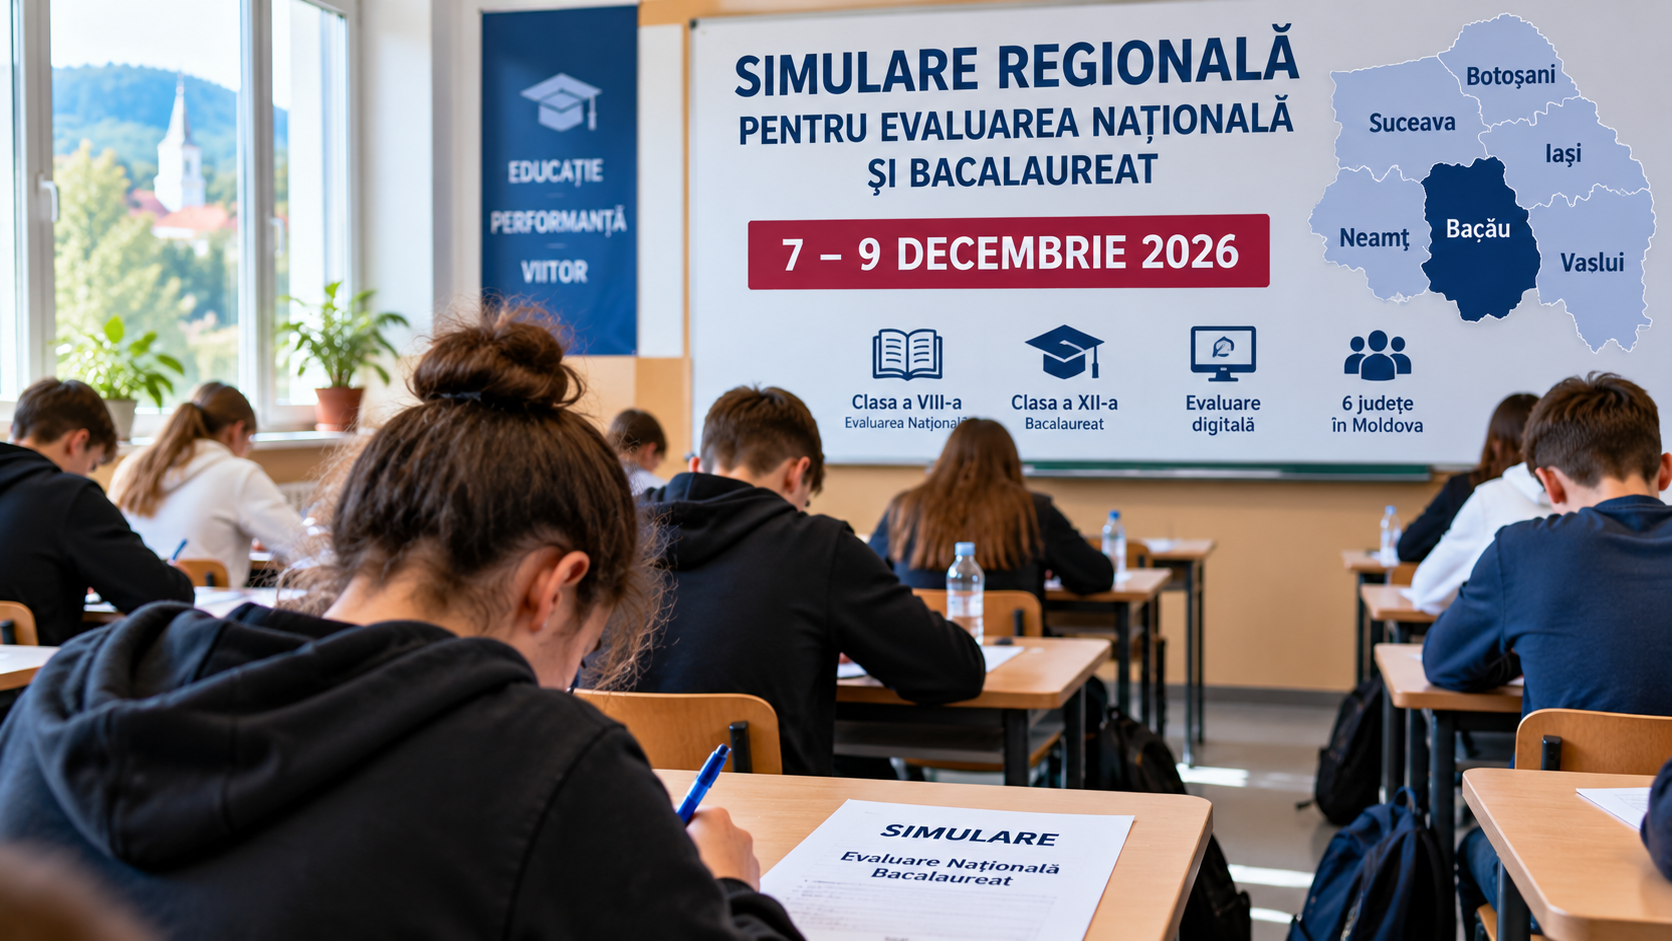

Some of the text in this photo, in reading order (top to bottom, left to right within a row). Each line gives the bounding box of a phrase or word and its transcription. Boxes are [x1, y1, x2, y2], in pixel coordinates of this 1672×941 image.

[734, 22, 1300, 98] SIMULARE REGIONALĂ
[739, 112, 867, 146] PENTRU
[881, 107, 1080, 142] EVALUAREA
[1369, 112, 1457, 134] Suceava
[910, 152, 1159, 188] BACALAUREAT
[782, 238, 804, 272] 7
[858, 237, 881, 271] 9
[897, 234, 1127, 271] DECEMBRIE
[1141, 233, 1240, 270] 2026
[521, 259, 588, 284] VIITOR
[852, 393, 963, 410] Clasa a VIII-a
[1011, 394, 1119, 411] Clasa a XII-a
[1186, 394, 1261, 411] Evaluare
[1342, 395, 1353, 411] 6
[845, 416, 904, 429] Evaluarea
[1025, 416, 1105, 430] Bacalaureat
[1192, 416, 1256, 436] digitală
[1331, 416, 1425, 433] în Moldova
[880, 823, 1060, 847] SIMULARE
[840, 851, 941, 867] Evaluare
[870, 867, 1014, 887] Bacalaureat
